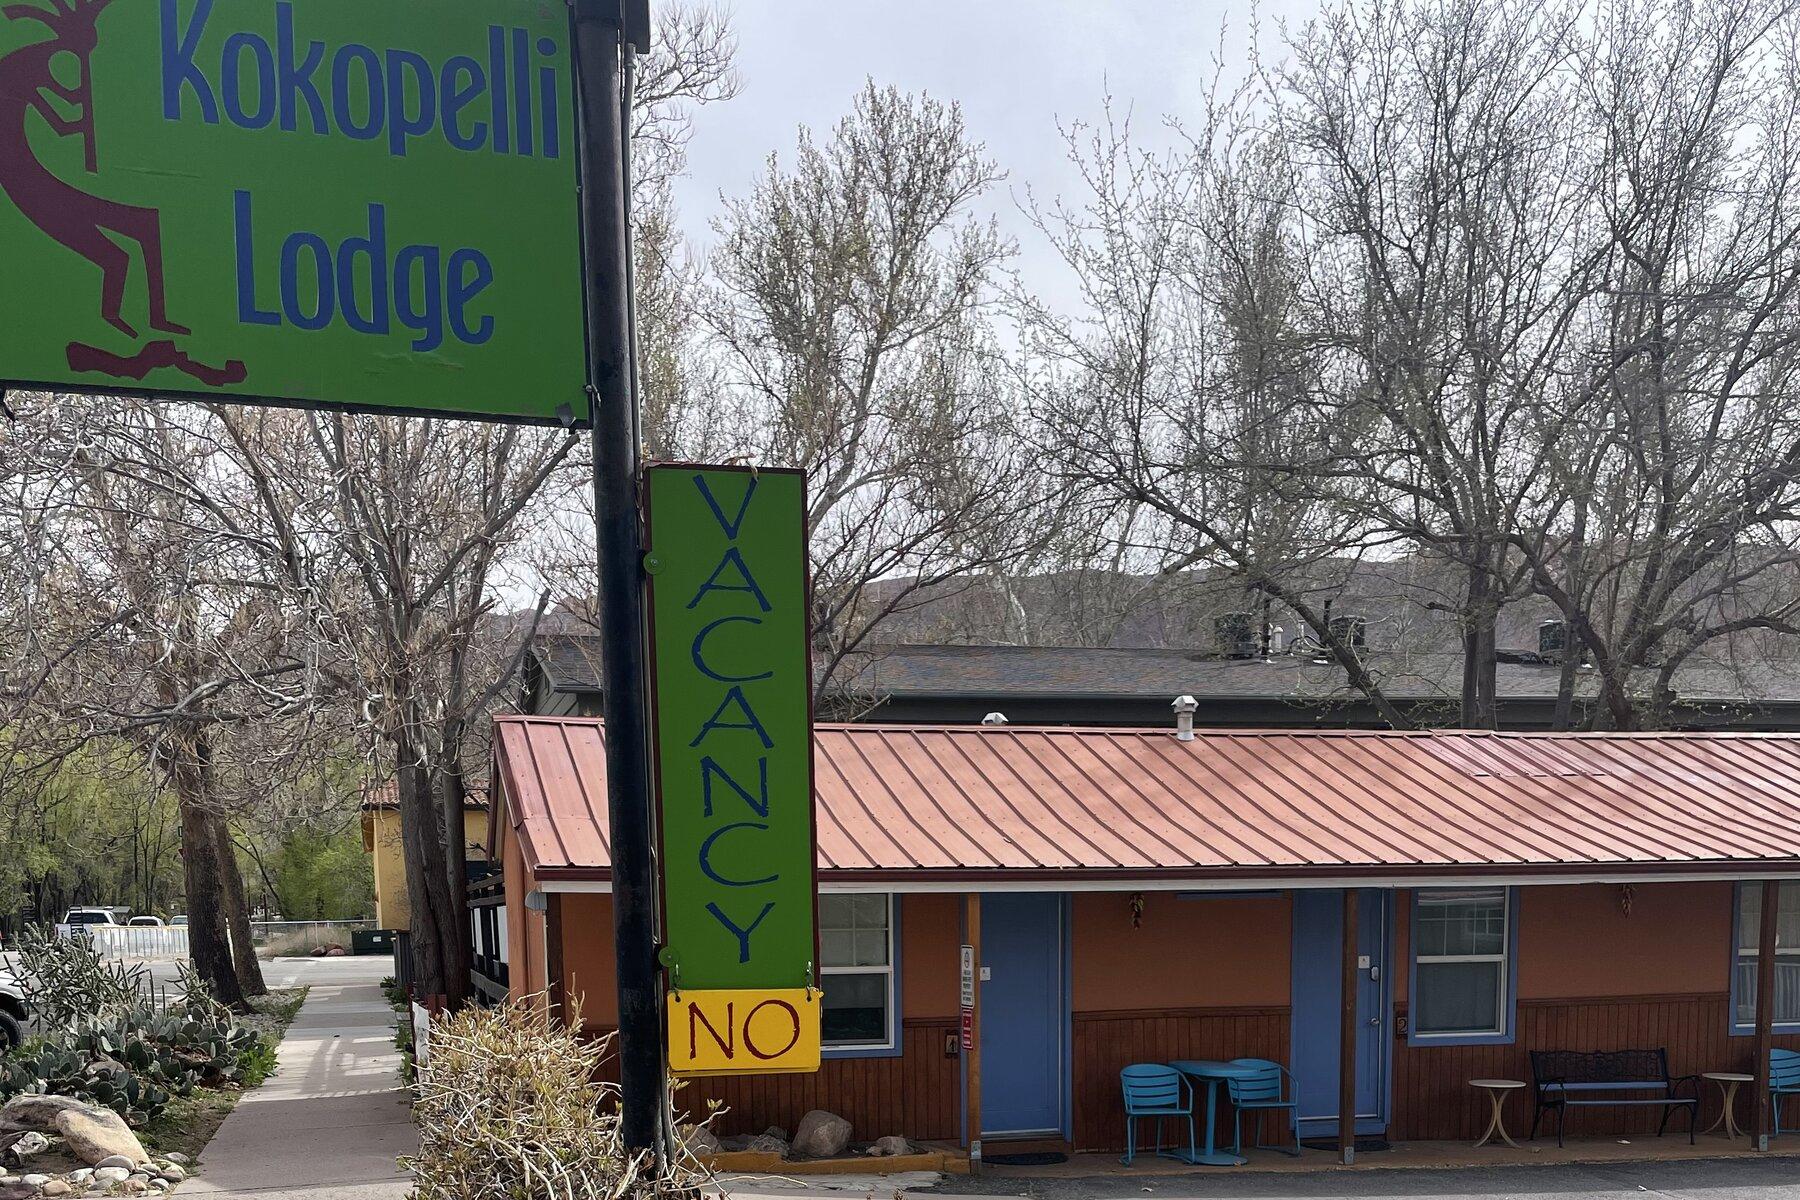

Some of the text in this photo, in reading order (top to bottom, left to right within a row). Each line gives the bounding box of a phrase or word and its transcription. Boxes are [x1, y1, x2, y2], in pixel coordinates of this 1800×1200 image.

[159, 0, 560, 159] Kokopelli
[233, 189, 496, 353] Lodge
[685, 473, 780, 964] VACANCY
[687, 998, 801, 1061] NO
[1398, 1018, 1408, 1034] 2
